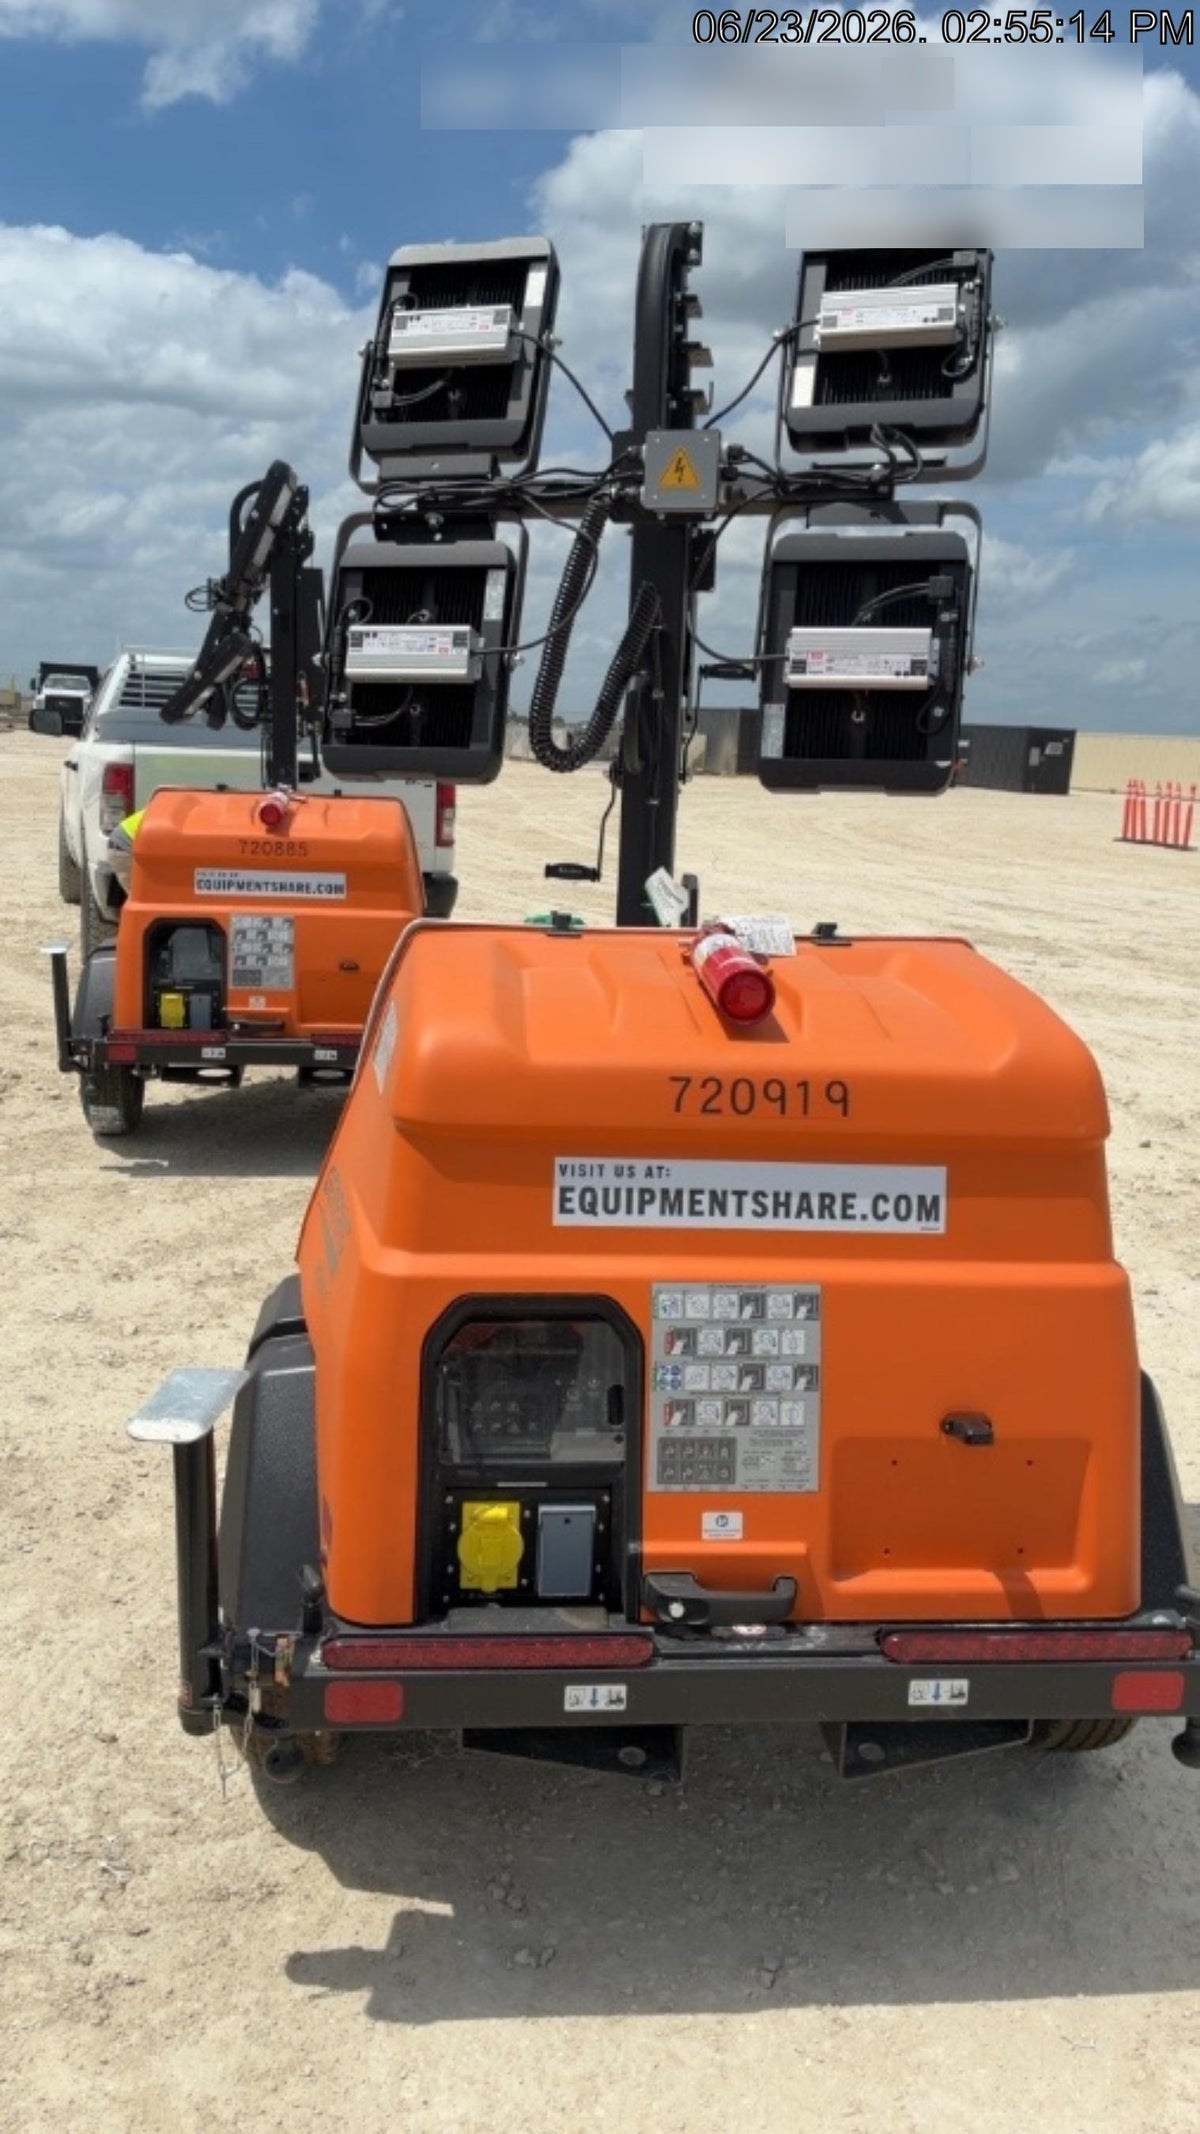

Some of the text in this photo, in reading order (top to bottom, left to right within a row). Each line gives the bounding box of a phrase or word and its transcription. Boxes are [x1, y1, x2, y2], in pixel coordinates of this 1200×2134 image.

[239, 839, 308, 857] 720885
[196, 878, 345, 895] EQUIPMENTSHARE.COM
[669, 1076, 849, 1117] 720919
[558, 1163, 672, 1180] VISIT US AT:
[558, 1185, 941, 1223] EQUIPMENTSHARE.COM
